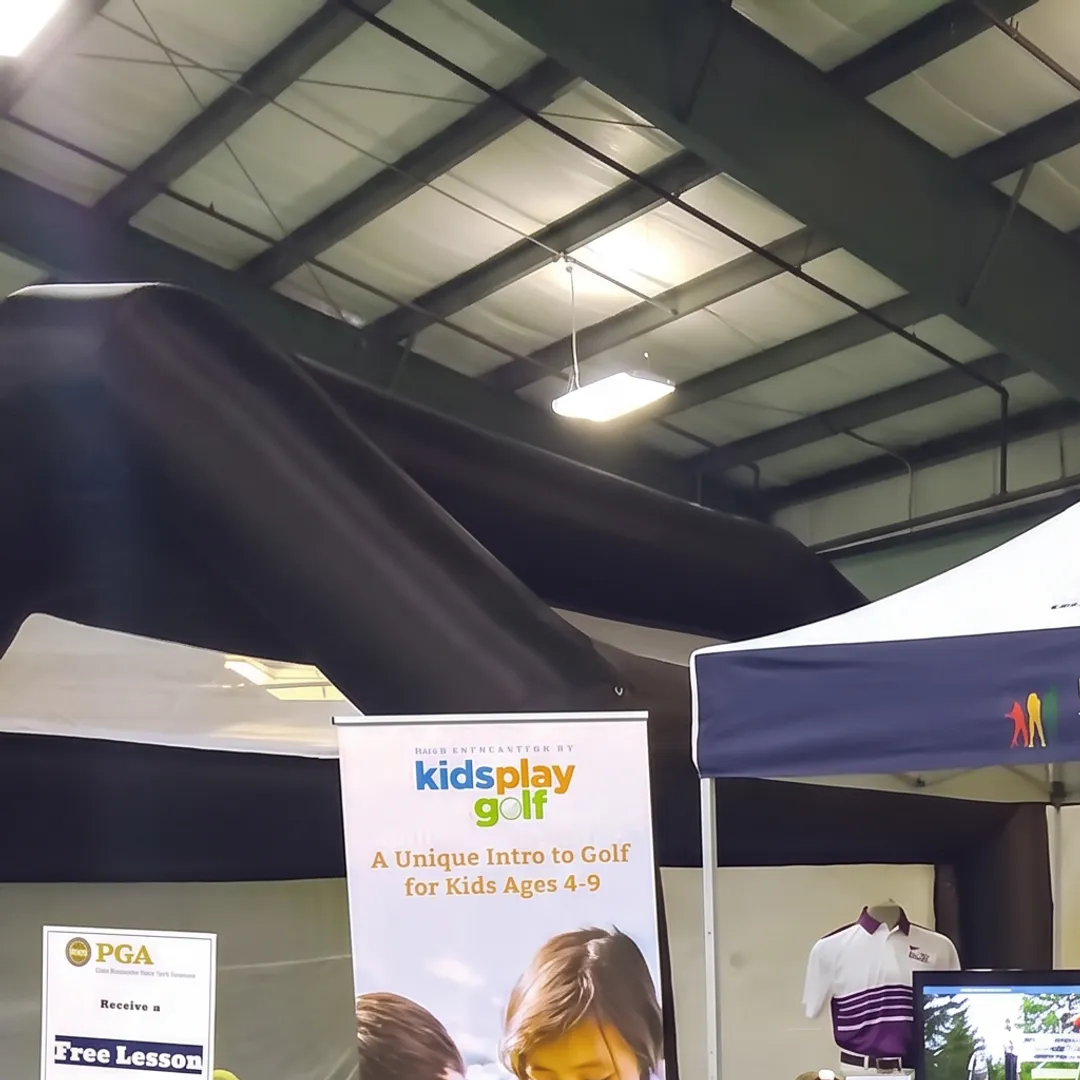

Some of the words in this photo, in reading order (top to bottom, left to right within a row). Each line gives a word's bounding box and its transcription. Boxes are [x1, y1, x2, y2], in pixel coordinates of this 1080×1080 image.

[415, 758, 576, 795] kidsplay
[474, 789, 548, 828] golf
[371, 851, 389, 869] A
[395, 848, 480, 872] Unique
[487, 848, 545, 866] Intro
[551, 847, 574, 864] to
[581, 843, 632, 863] Golf
[405, 877, 439, 896] for
[446, 876, 497, 895] Kids
[503, 876, 557, 899] Ages
[564, 874, 601, 892] 4-9
[95, 943, 154, 965] PGA
[100, 999, 148, 1012] Receive
[55, 1041, 111, 1063] Free
[115, 1045, 203, 1070] Lesson
